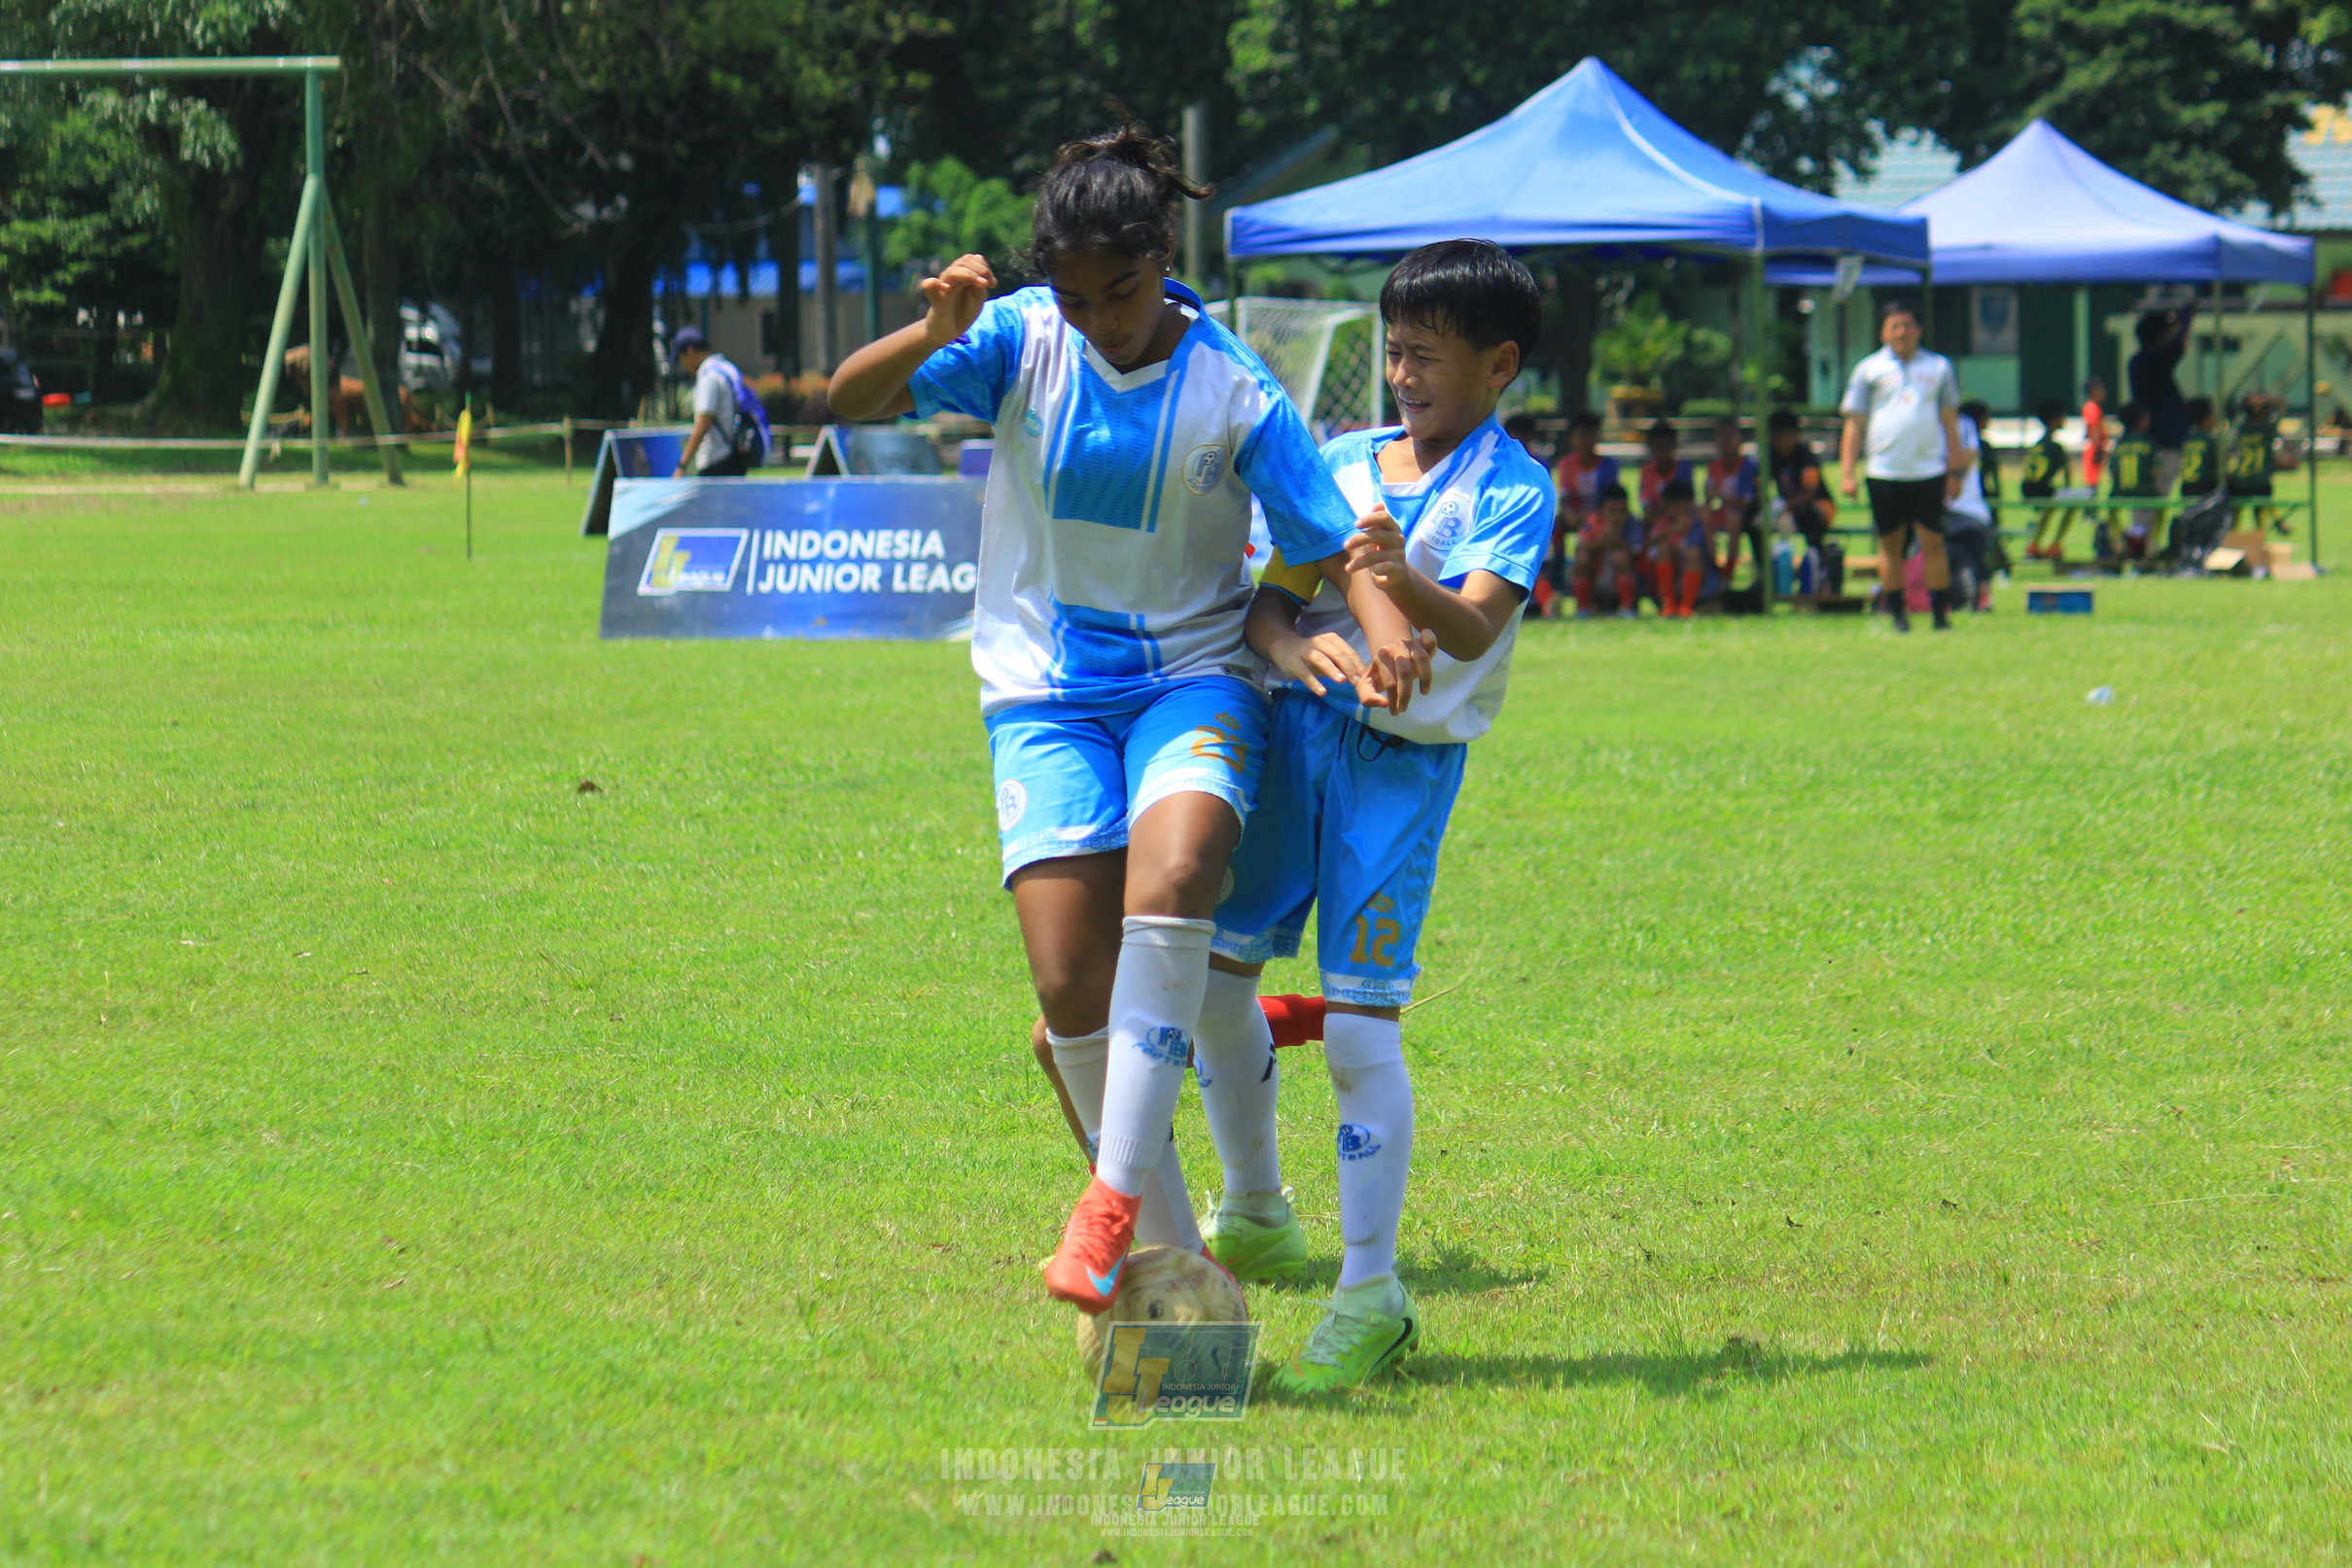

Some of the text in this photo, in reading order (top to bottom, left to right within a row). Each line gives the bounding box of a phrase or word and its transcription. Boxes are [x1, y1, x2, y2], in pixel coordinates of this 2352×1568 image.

[762, 528, 946, 561] INDONESIA
[757, 562, 882, 594] JUNIOR
[892, 561, 978, 594] LEAG
[1350, 915, 1401, 967] 12
